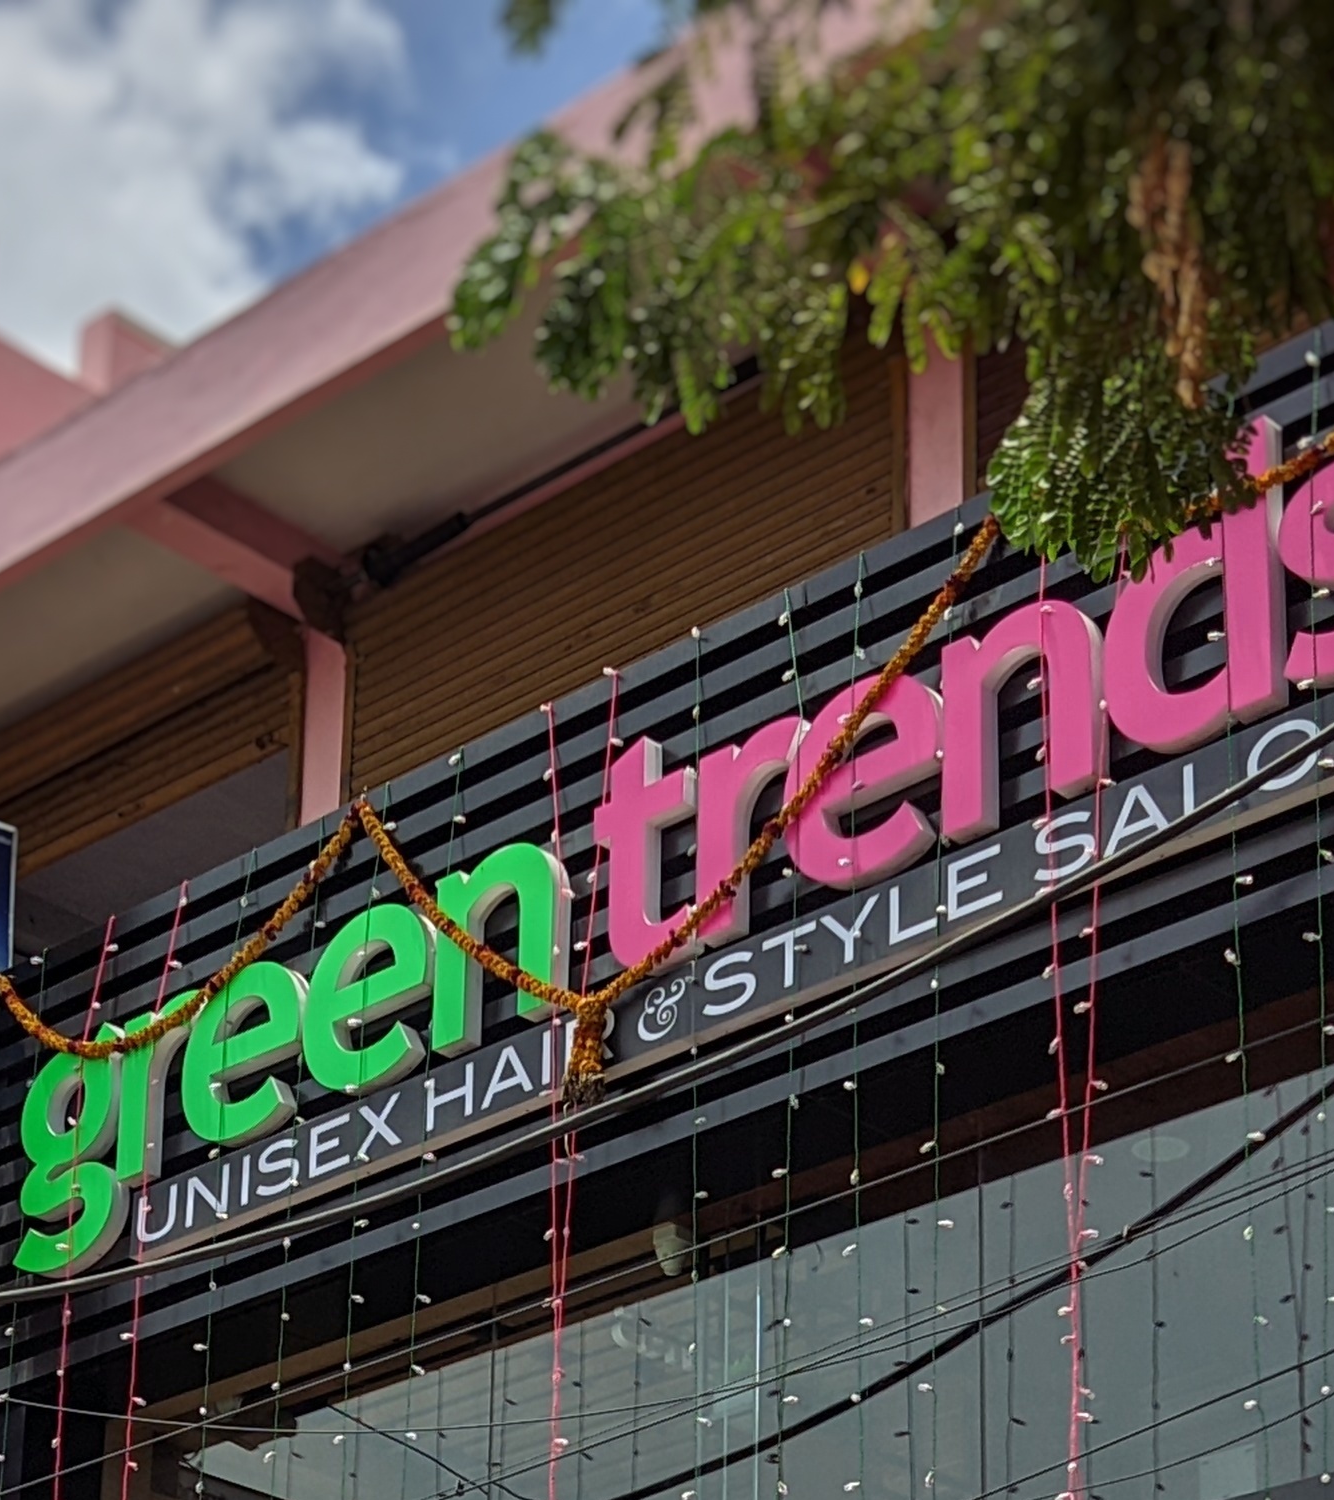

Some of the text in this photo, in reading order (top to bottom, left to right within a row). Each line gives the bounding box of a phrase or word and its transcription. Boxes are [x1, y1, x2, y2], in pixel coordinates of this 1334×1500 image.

[13, 842, 569, 1275] green
[133, 1092, 403, 1243] UNISEX
[637, 978, 686, 1043] &
[701, 843, 1005, 1018] STYLE
